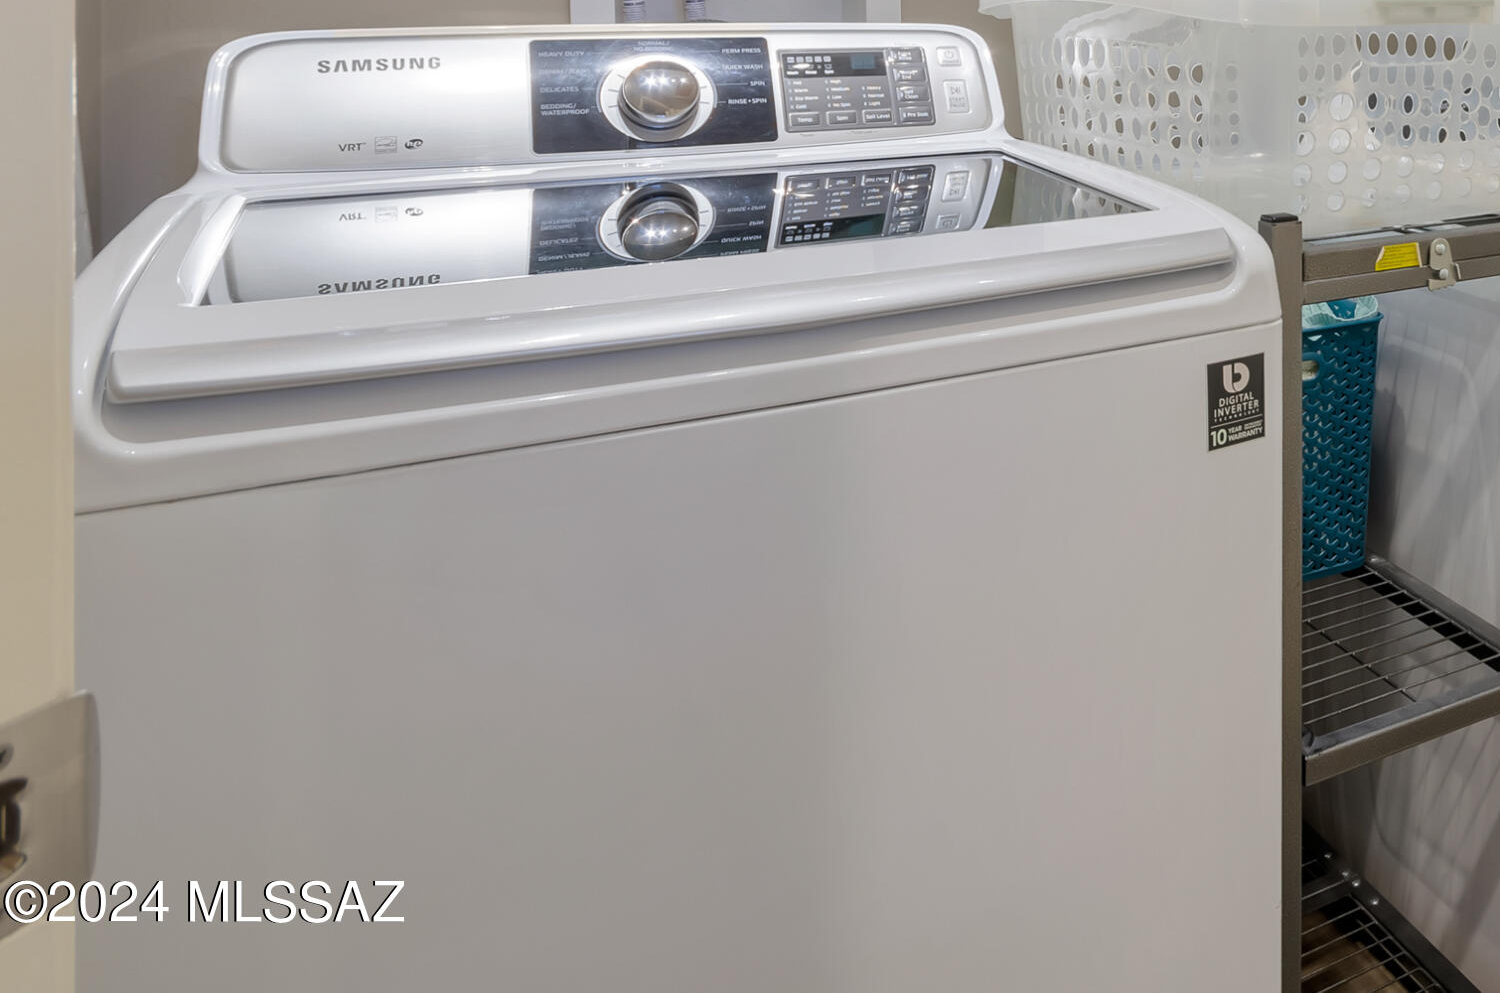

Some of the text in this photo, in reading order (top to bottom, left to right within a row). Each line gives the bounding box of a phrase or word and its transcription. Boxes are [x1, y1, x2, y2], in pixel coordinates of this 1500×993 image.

[317, 56, 442, 74] SAMSUNG
[1213, 399, 1260, 418] INVERTER
[1218, 391, 1254, 408] DIGITAL
[1210, 425, 1242, 447] 10 YEAR
[1228, 427, 1263, 442] WARRANTY
